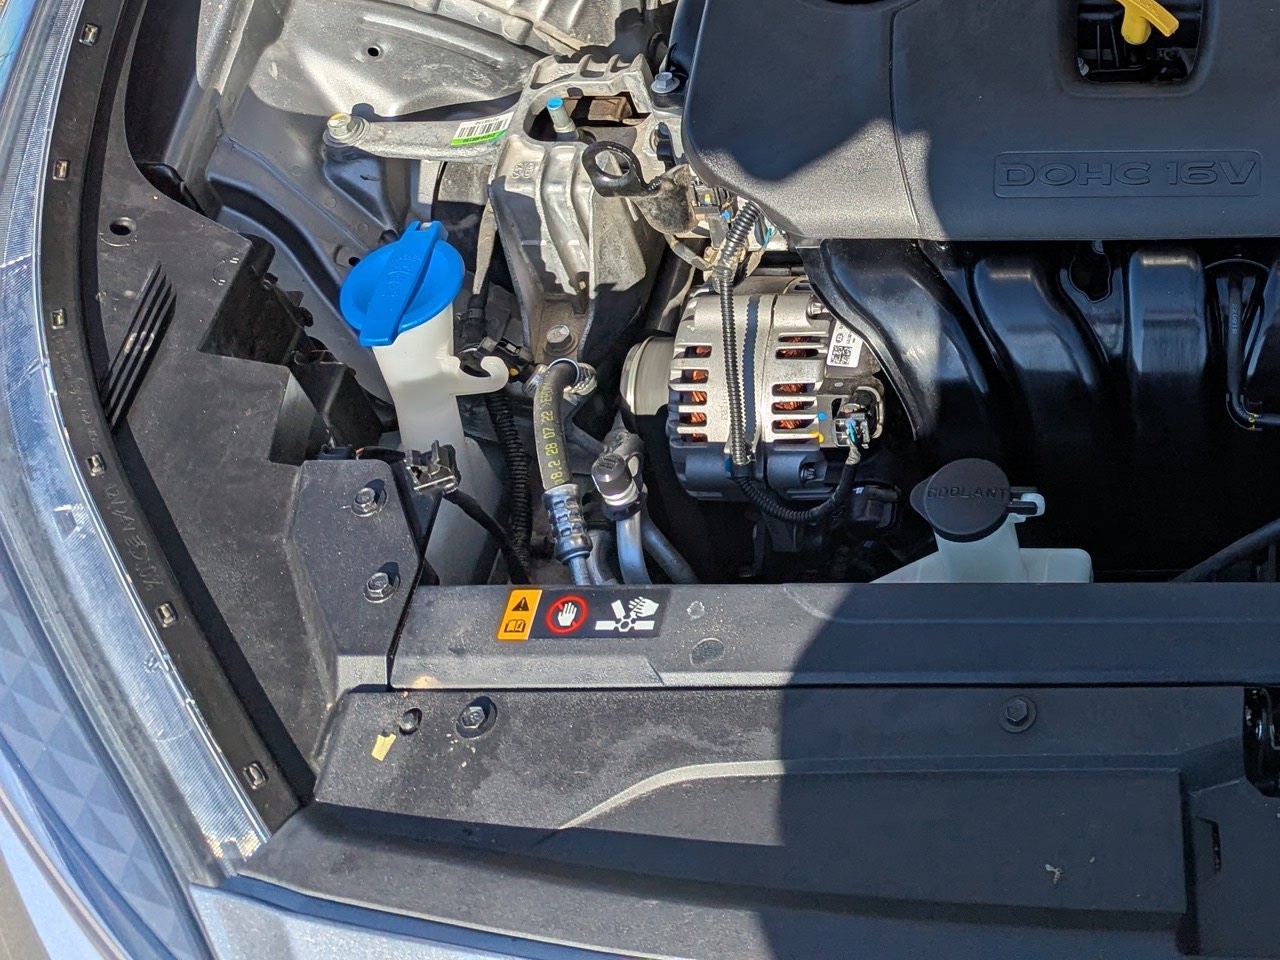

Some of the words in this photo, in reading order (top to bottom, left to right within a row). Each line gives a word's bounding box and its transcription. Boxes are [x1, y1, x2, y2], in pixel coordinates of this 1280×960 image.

[999, 161, 1151, 187] DOHC
[1165, 160, 1256, 186] 16V
[541, 410, 554, 422] 22
[543, 427, 555, 438] 07
[545, 442, 558, 455] 28
[926, 486, 1006, 500] COOLANT
